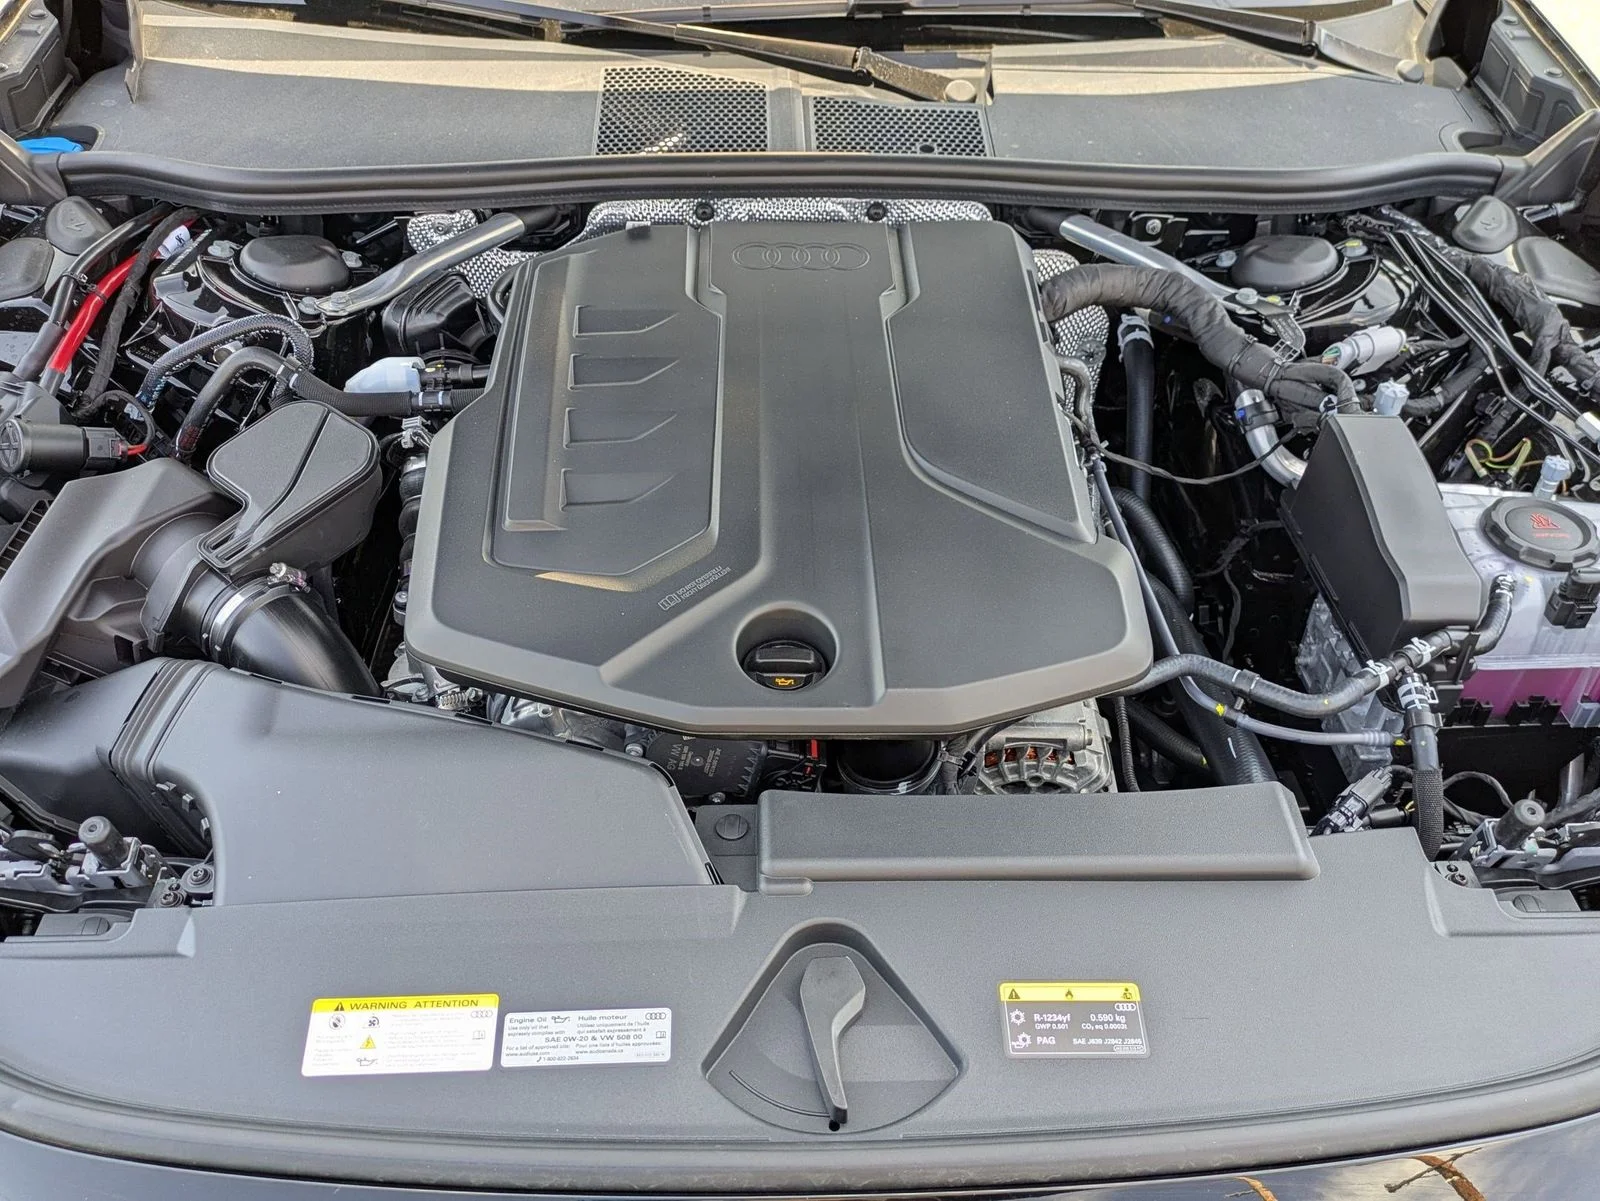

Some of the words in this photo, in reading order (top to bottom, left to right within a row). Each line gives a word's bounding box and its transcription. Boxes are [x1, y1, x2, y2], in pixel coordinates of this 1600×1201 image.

[350, 1001, 407, 1010] WARNING
[414, 999, 479, 1009] ATTENTION
[1033, 1013, 1071, 1023] R-1234yf
[1090, 1013, 1114, 1022] 0.590
[1115, 1013, 1126, 1023] kg
[1036, 1036, 1056, 1045] PAG
